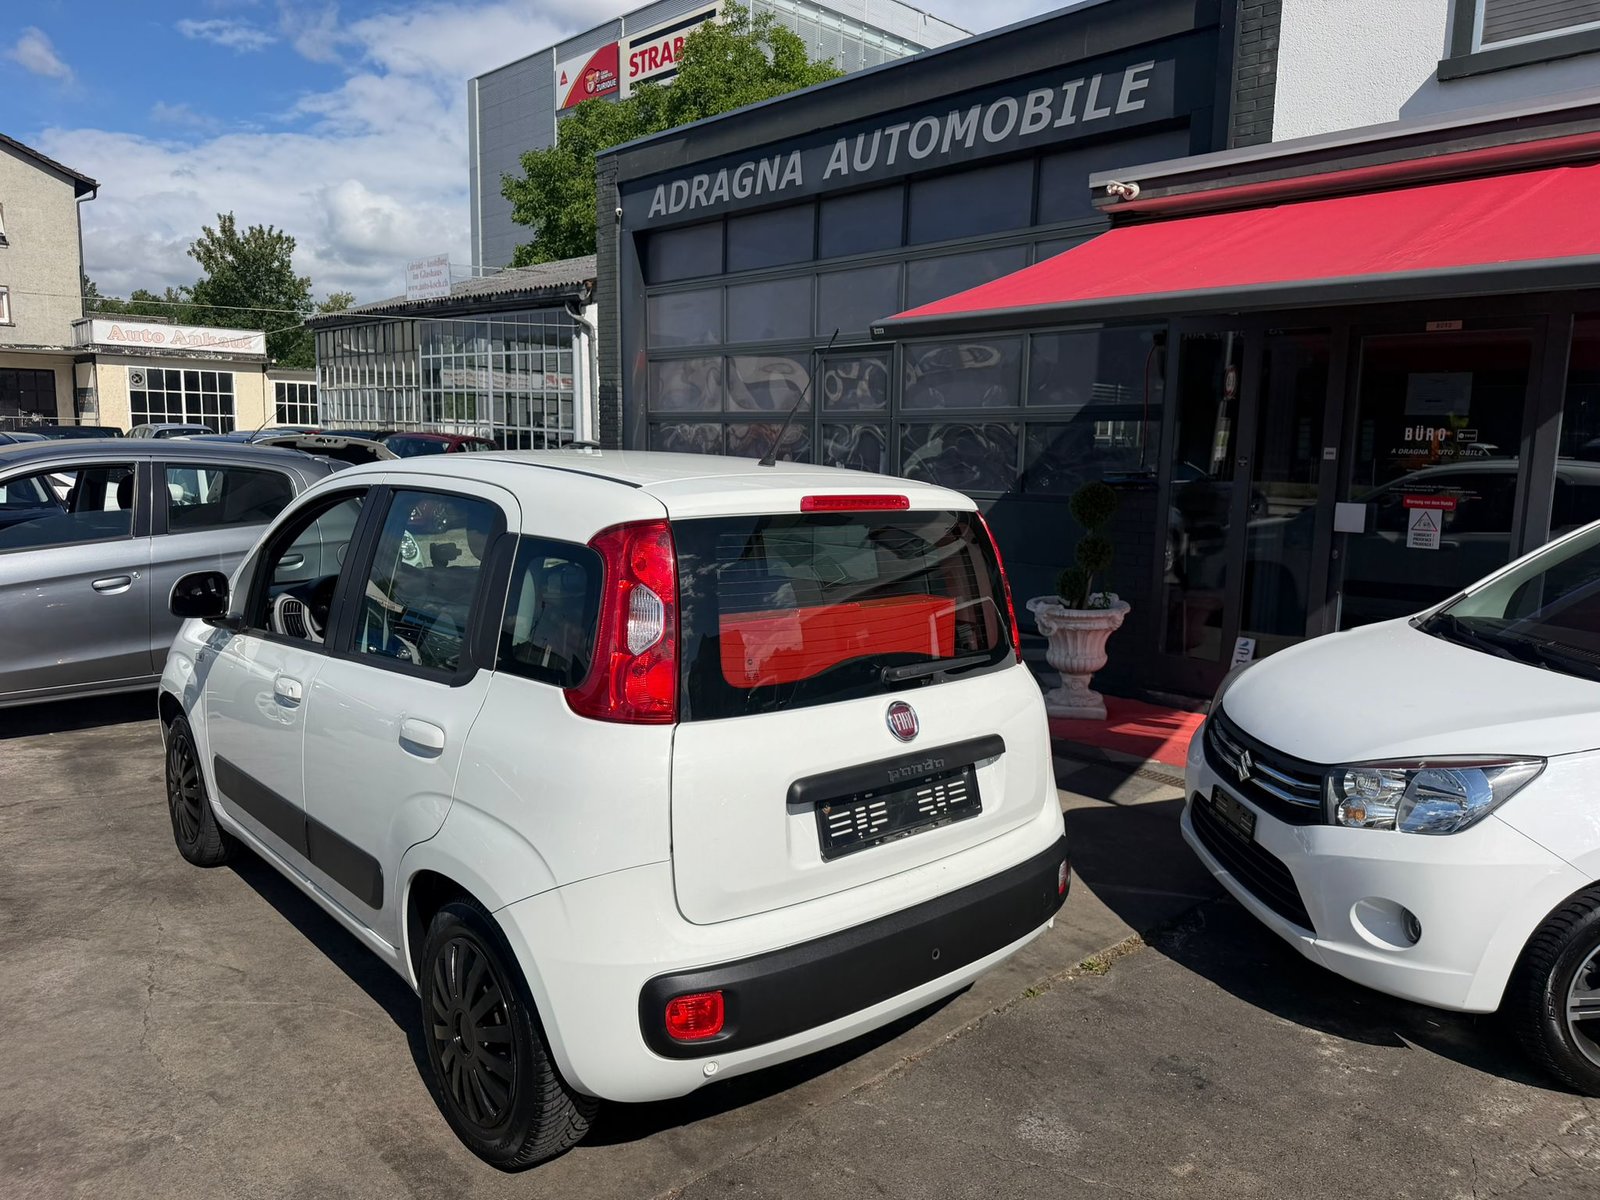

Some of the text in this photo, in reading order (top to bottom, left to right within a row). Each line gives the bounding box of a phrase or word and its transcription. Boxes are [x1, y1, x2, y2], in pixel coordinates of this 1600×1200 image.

[629, 36, 685, 77] STRAB
[648, 60, 1155, 218] ADRAGNA AUTOMOBILE
[107, 324, 166, 343] Auto
[1404, 425, 1447, 441] BÜRO
[893, 711, 914, 731] FIAT
[887, 758, 945, 783] panda
